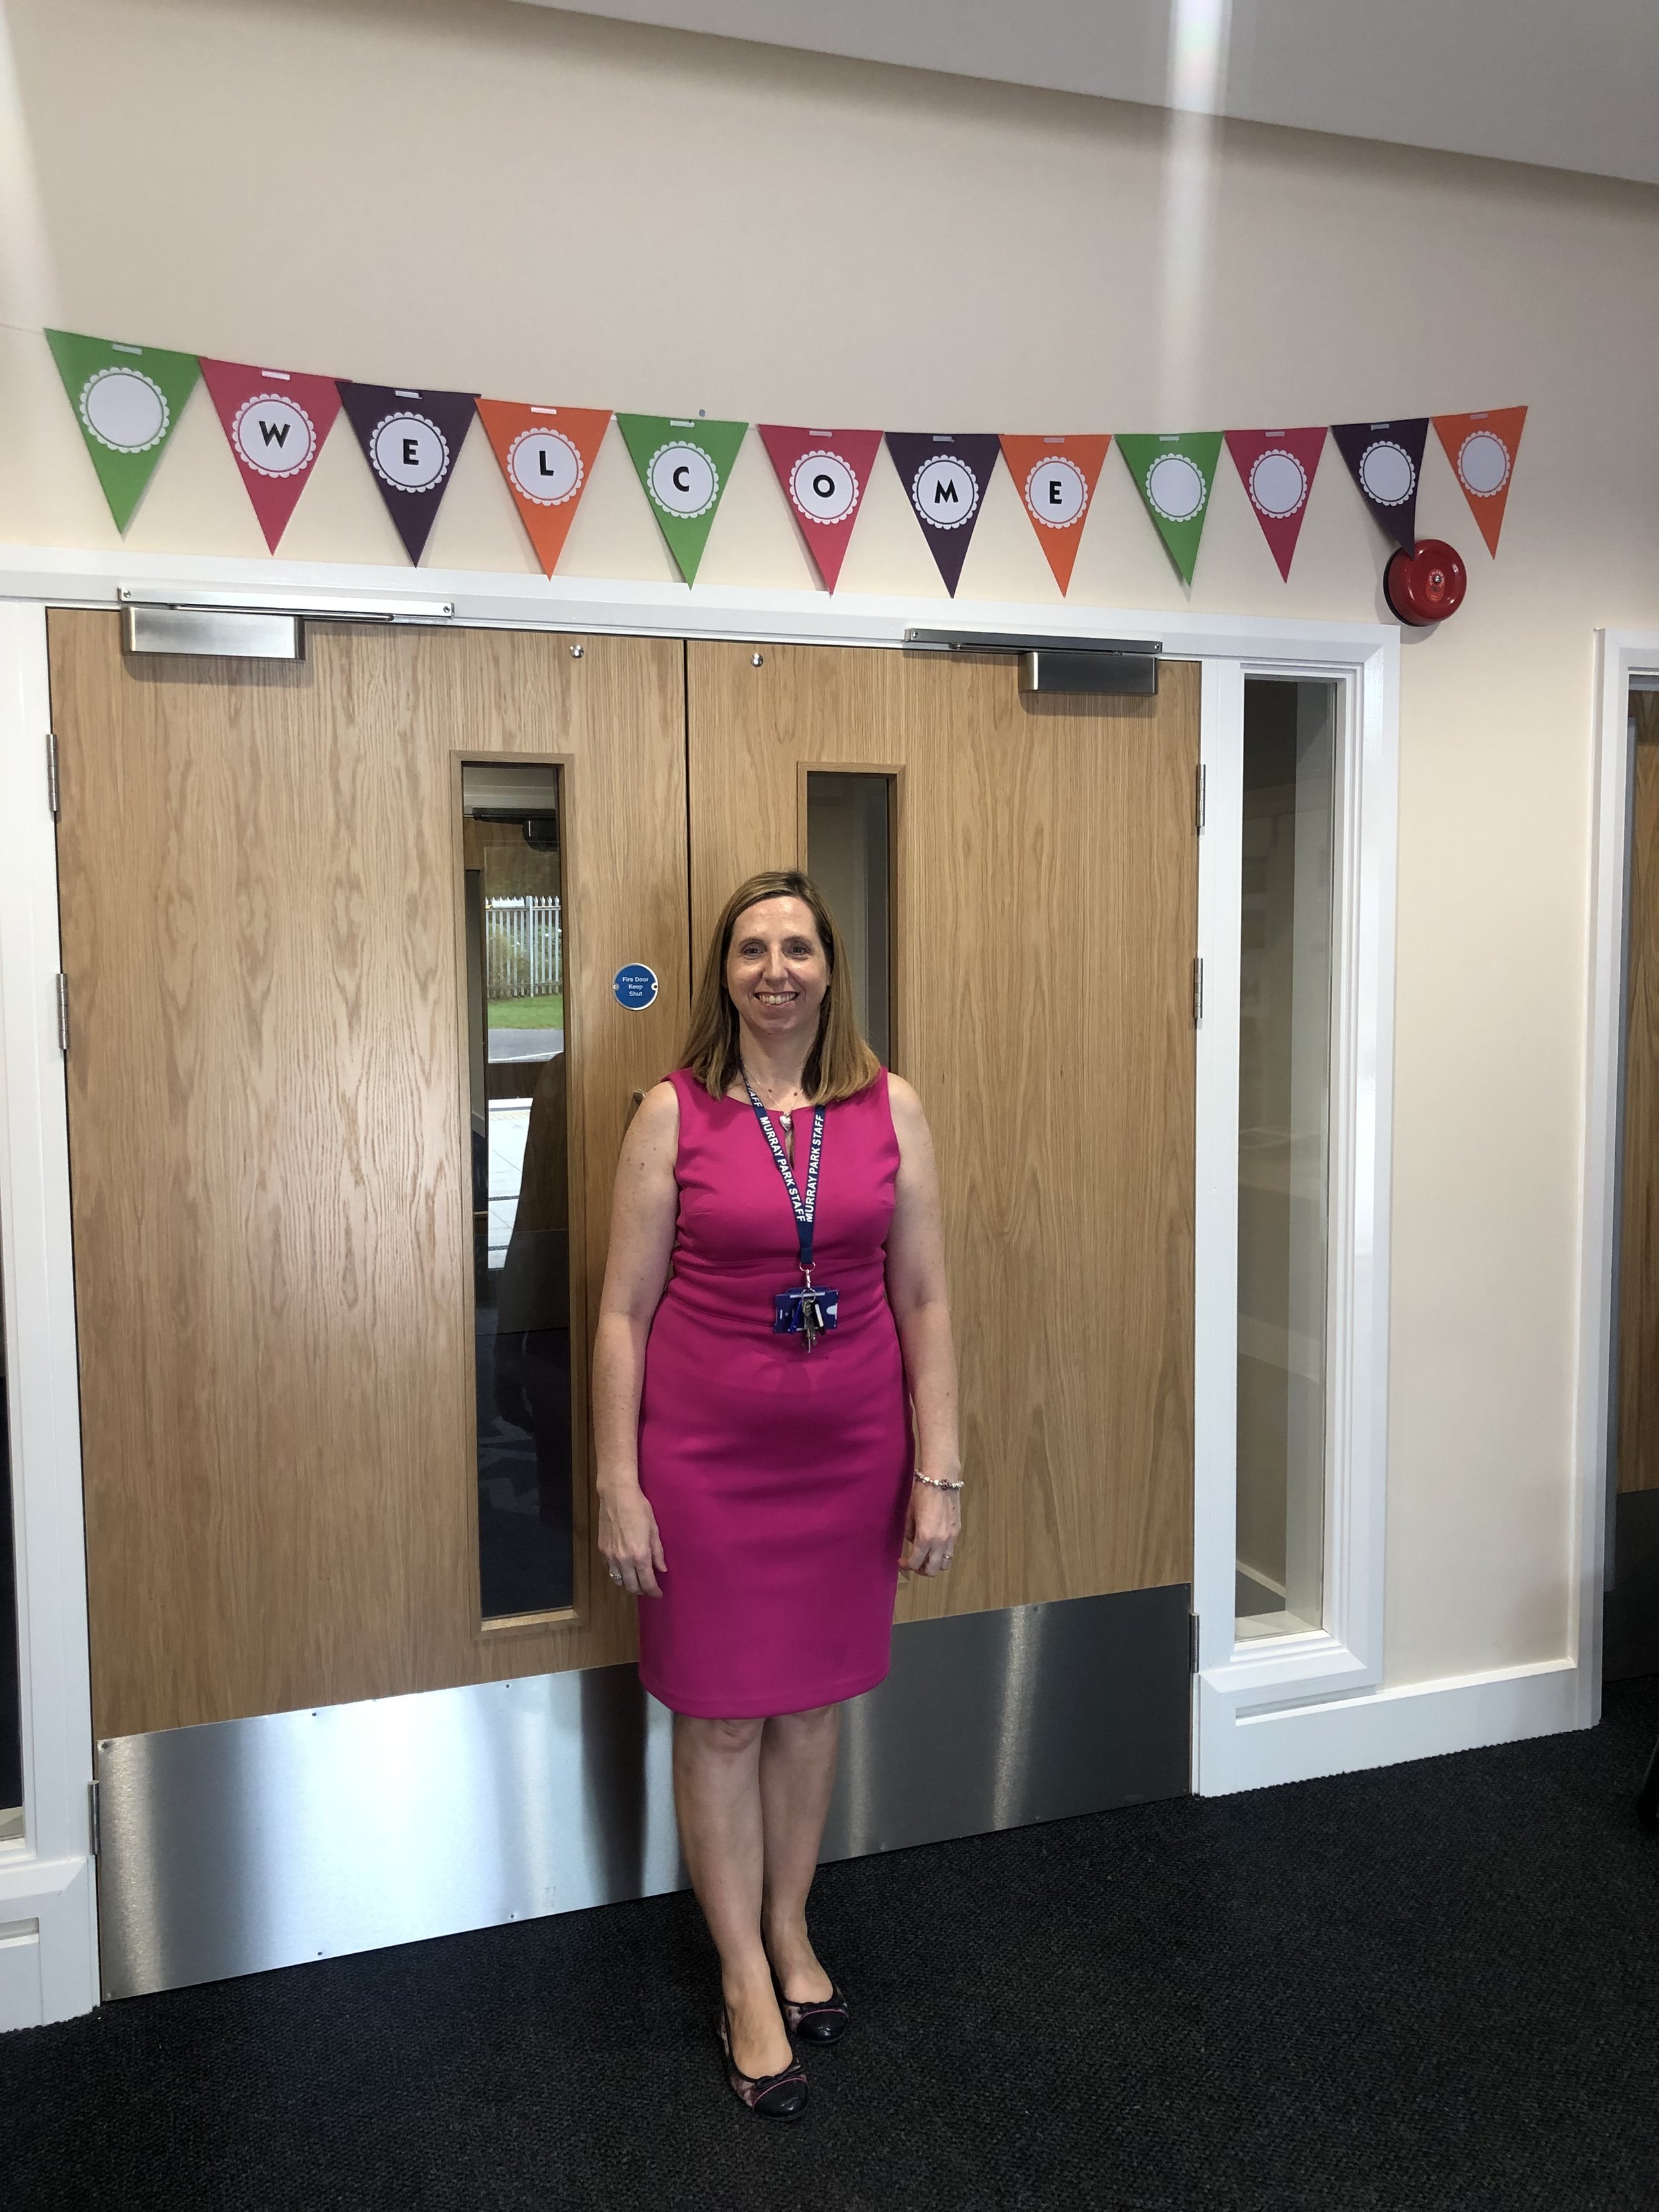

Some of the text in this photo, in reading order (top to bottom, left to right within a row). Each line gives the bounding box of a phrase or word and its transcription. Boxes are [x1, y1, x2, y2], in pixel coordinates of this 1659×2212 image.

[258, 420, 1062, 505] WELCOME
[760, 1116, 805, 1222] MURRAY PARK STAFF
[805, 1114, 824, 1223] MURRAY PARK STAFF
